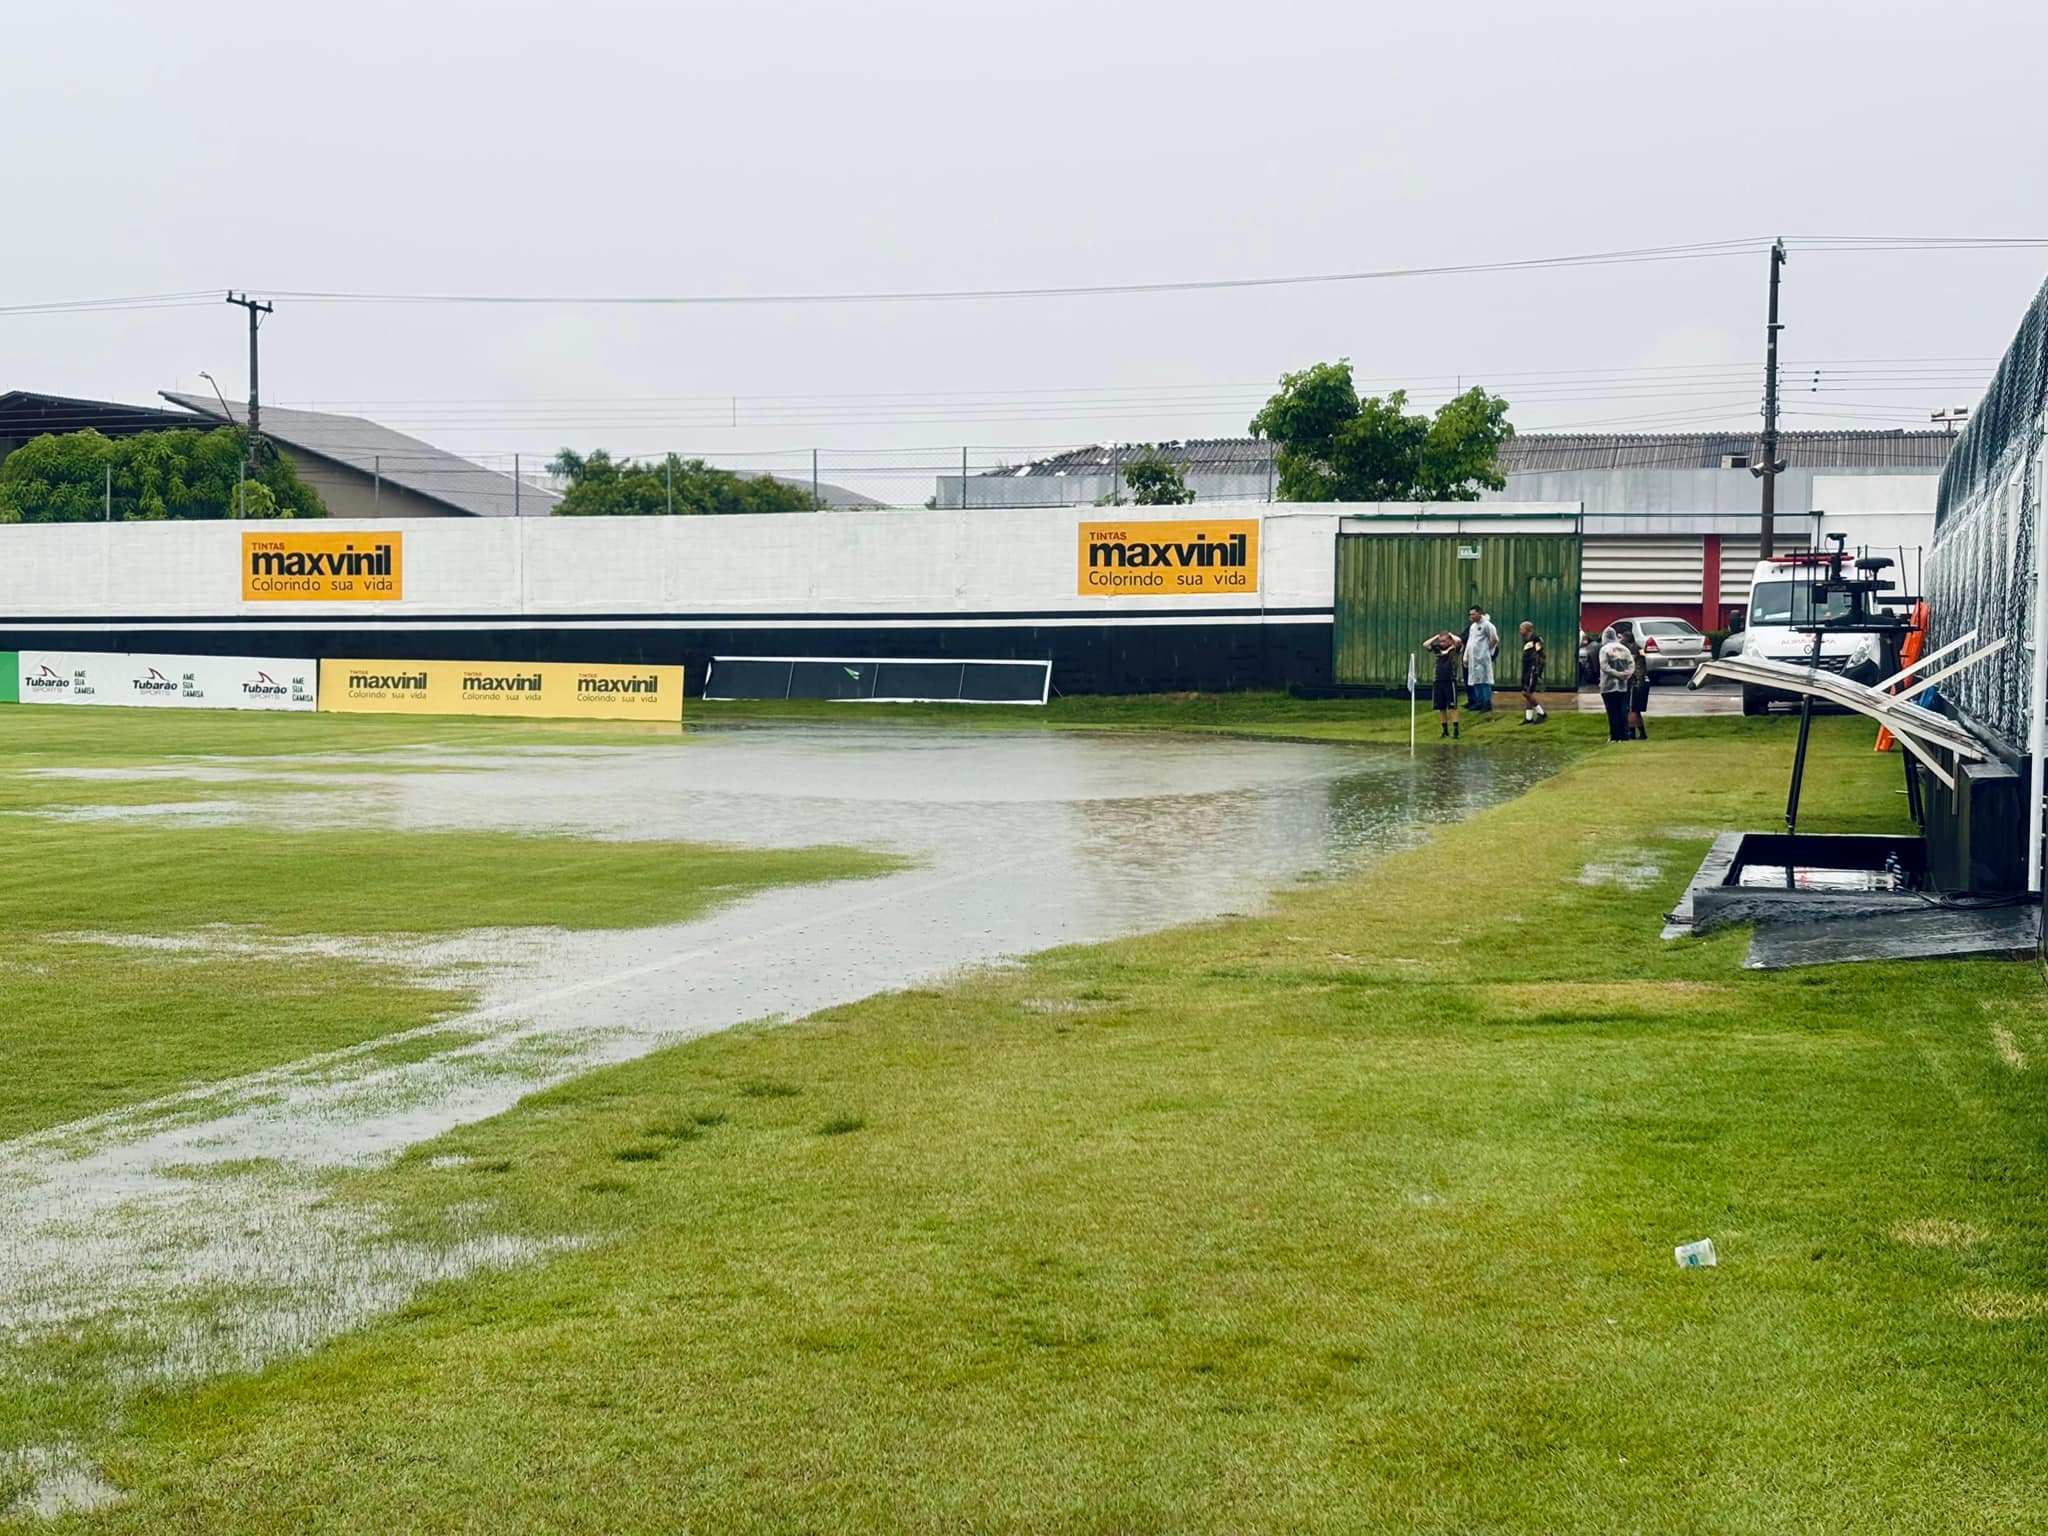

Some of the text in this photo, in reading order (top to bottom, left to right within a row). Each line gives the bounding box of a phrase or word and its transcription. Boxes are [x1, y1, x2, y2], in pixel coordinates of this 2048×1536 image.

[1089, 531, 1127, 541] TINTAS
[252, 542, 285, 551] TINTAS
[1089, 533, 1247, 567] maxvinil
[252, 544, 391, 576] maxvinil
[1089, 570, 1246, 586] Colorindo sua vida
[252, 577, 393, 591] Colorindo sua vida
[292, 677, 304, 685] AME
[349, 672, 427, 689] maxvinil
[462, 673, 542, 691] maxvinil
[577, 675, 658, 693] maxvinil
[292, 685, 304, 693] SUA
[292, 694, 313, 702] CAMISA
[348, 690, 386, 698] Colorindo
[410, 691, 427, 699] vida
[462, 692, 501, 700] Colorindo
[525, 693, 542, 701] vida
[577, 693, 616, 702] Colorindo
[641, 694, 658, 703] vida
